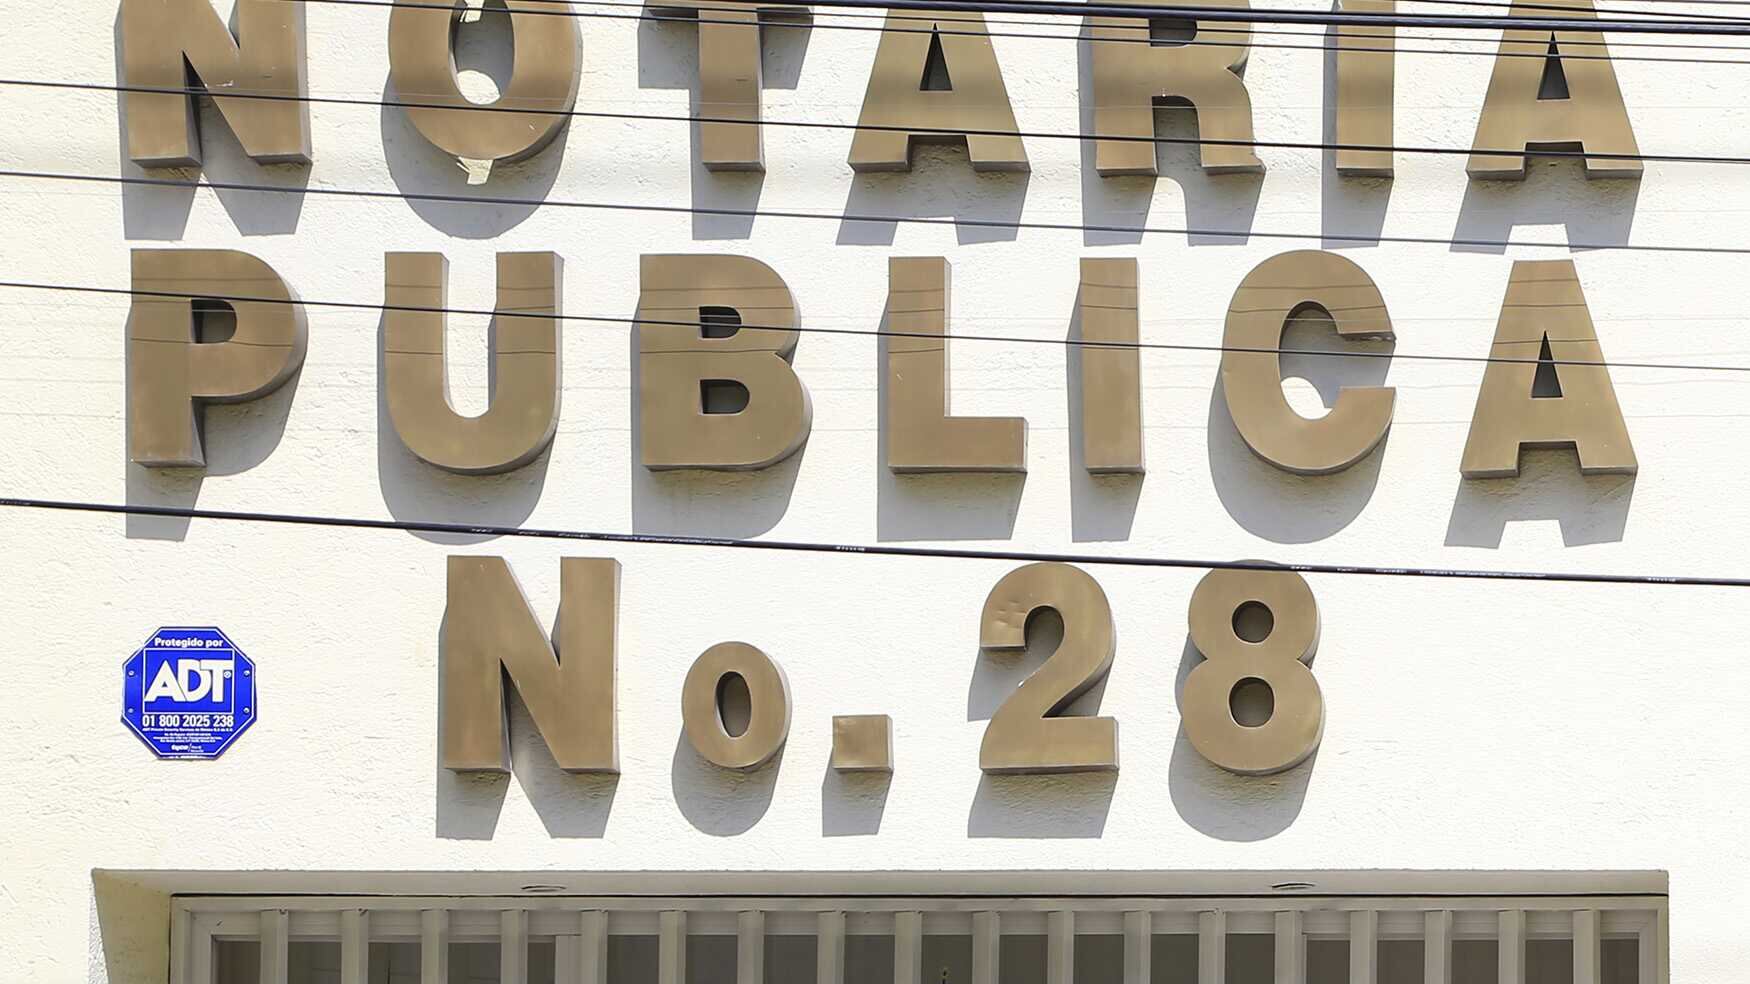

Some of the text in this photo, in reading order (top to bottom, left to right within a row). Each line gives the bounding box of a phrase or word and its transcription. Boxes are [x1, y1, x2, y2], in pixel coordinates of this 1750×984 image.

[114, 0, 1645, 181] NOTARIA
[130, 247, 1638, 477] PUBLICA
[144, 658, 234, 703] ADT
[154, 638, 224, 648] Protegido por
[442, 555, 1326, 774] No. 28
[142, 714, 234, 727] 01 800 2025 238
